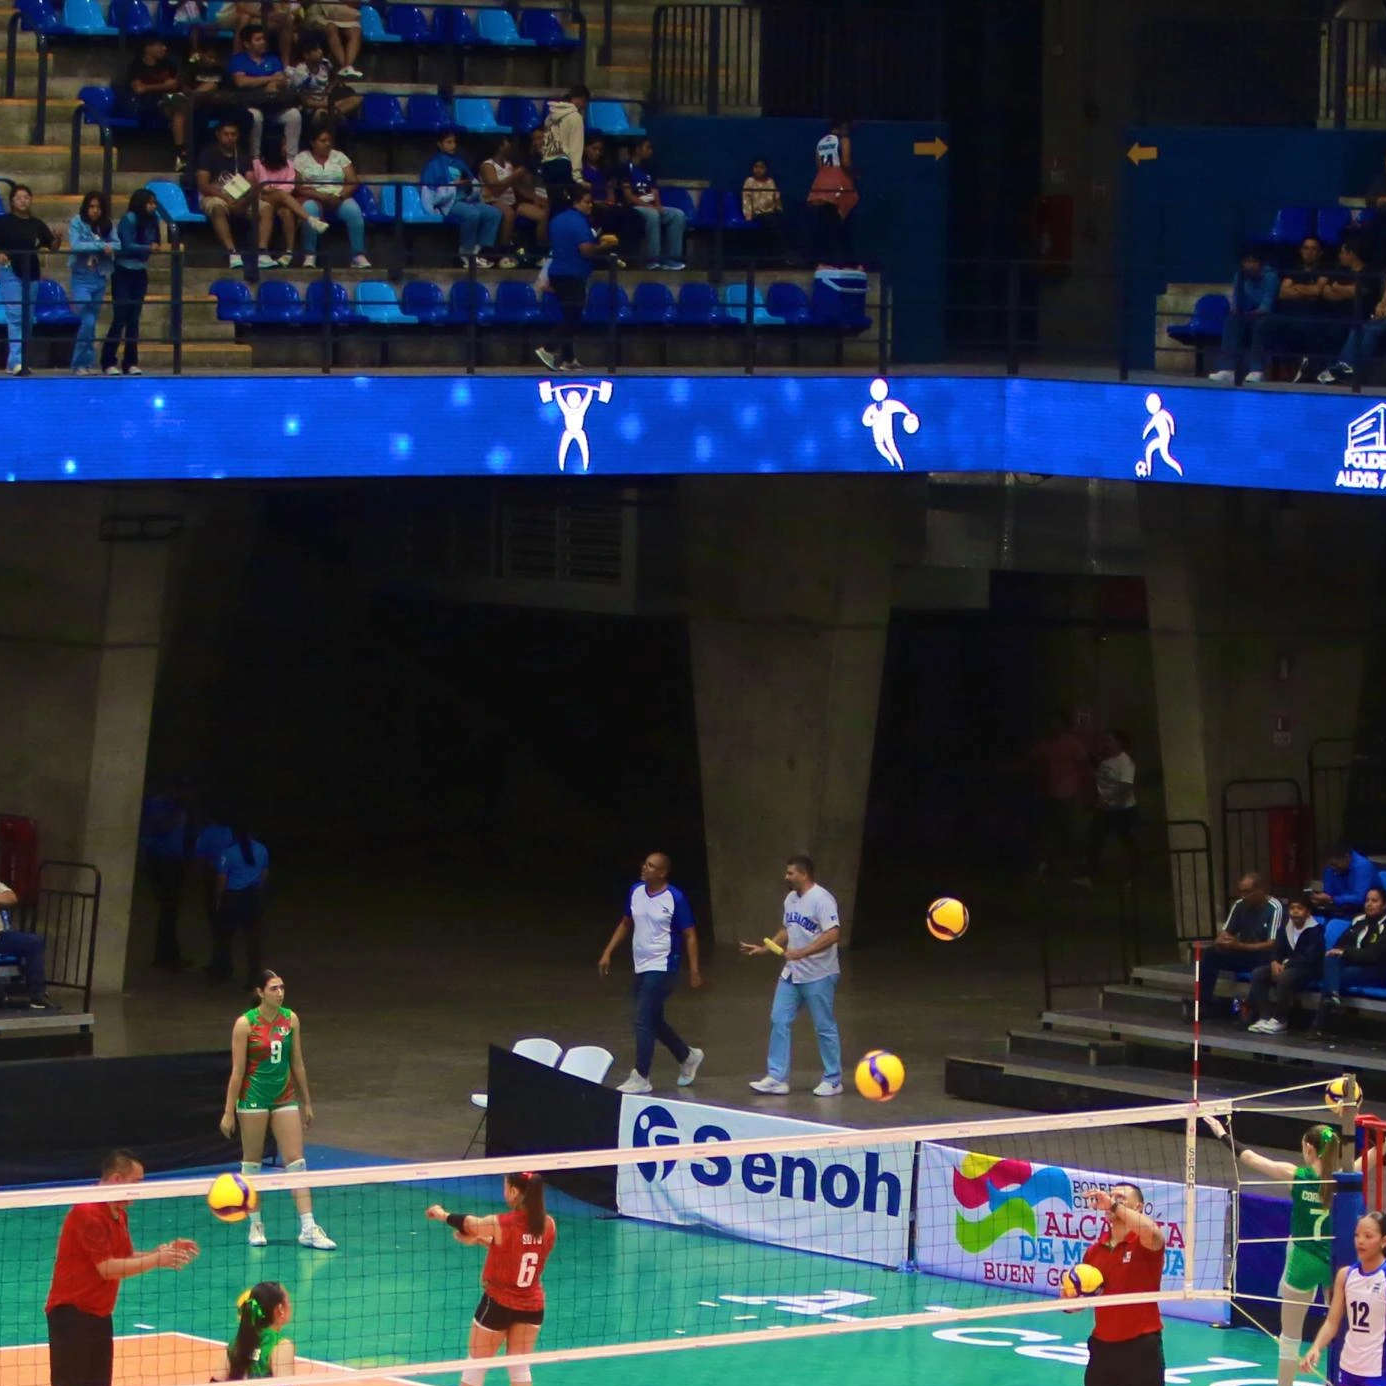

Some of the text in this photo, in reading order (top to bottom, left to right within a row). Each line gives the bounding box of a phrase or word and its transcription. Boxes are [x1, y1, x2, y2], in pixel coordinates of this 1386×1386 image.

[1335, 470, 1379, 489] ALEXIS
[270, 1040, 283, 1064] 9
[690, 1124, 902, 1217] Senoh
[1309, 1208, 1330, 1241] 7
[1019, 1235, 1055, 1264] DE
[516, 1252, 539, 1288] 6
[984, 1262, 1035, 1284] BUEN
[1349, 1302, 1370, 1329] 12
